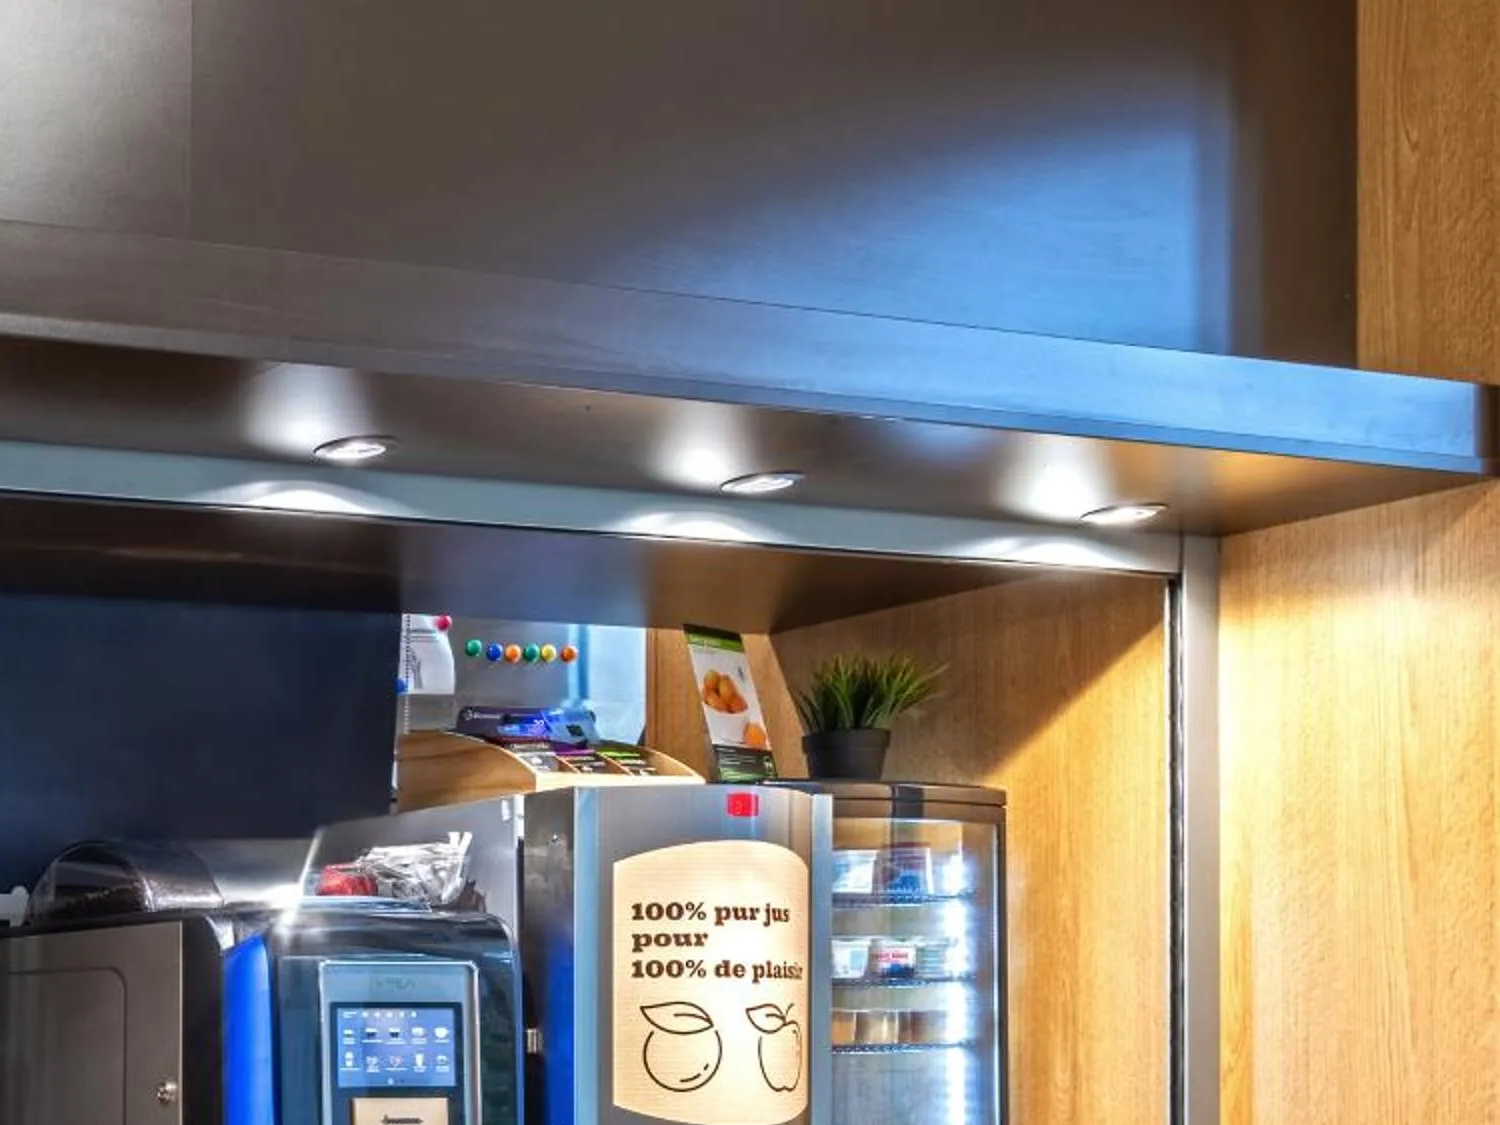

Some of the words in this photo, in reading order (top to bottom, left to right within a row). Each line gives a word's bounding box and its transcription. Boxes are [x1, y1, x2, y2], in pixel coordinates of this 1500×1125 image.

[631, 901, 707, 921] 100%
[714, 905, 760, 926] pur
[763, 902, 790, 927] jus
[631, 932, 708, 953] pour
[631, 959, 707, 979] 100%
[714, 959, 746, 978] de
